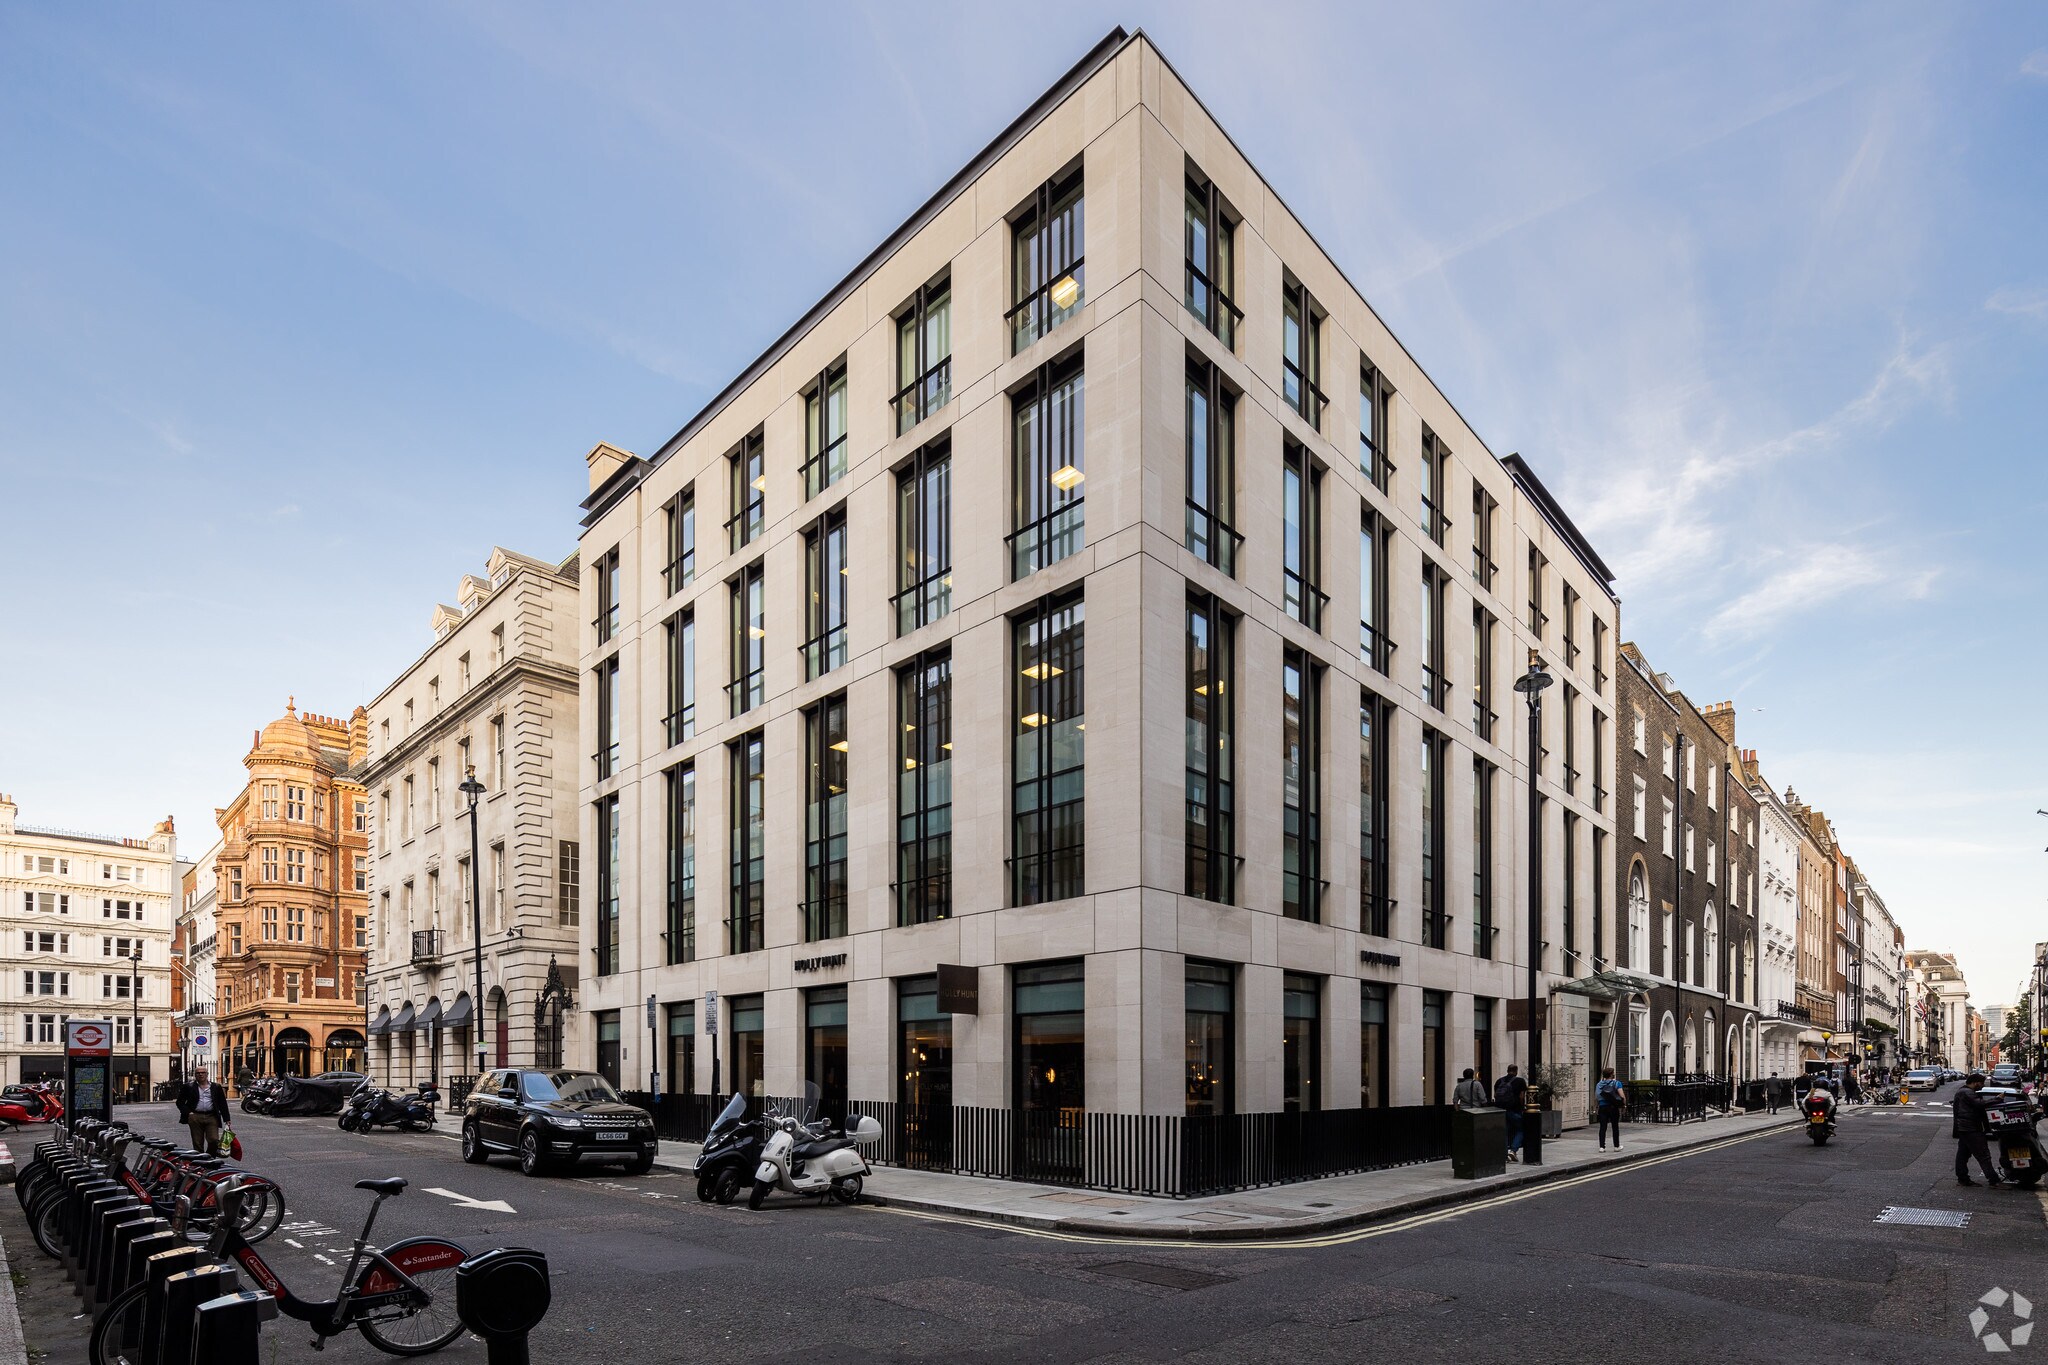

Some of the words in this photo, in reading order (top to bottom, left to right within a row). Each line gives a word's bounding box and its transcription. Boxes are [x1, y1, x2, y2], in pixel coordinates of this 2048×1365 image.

[821, 954, 847, 968] HUNT
[961, 989, 978, 999] HUNT
[1991, 1112, 2000, 1120] L
[412, 1251, 452, 1264] Santander
[384, 1292, 410, 1304] 16321
